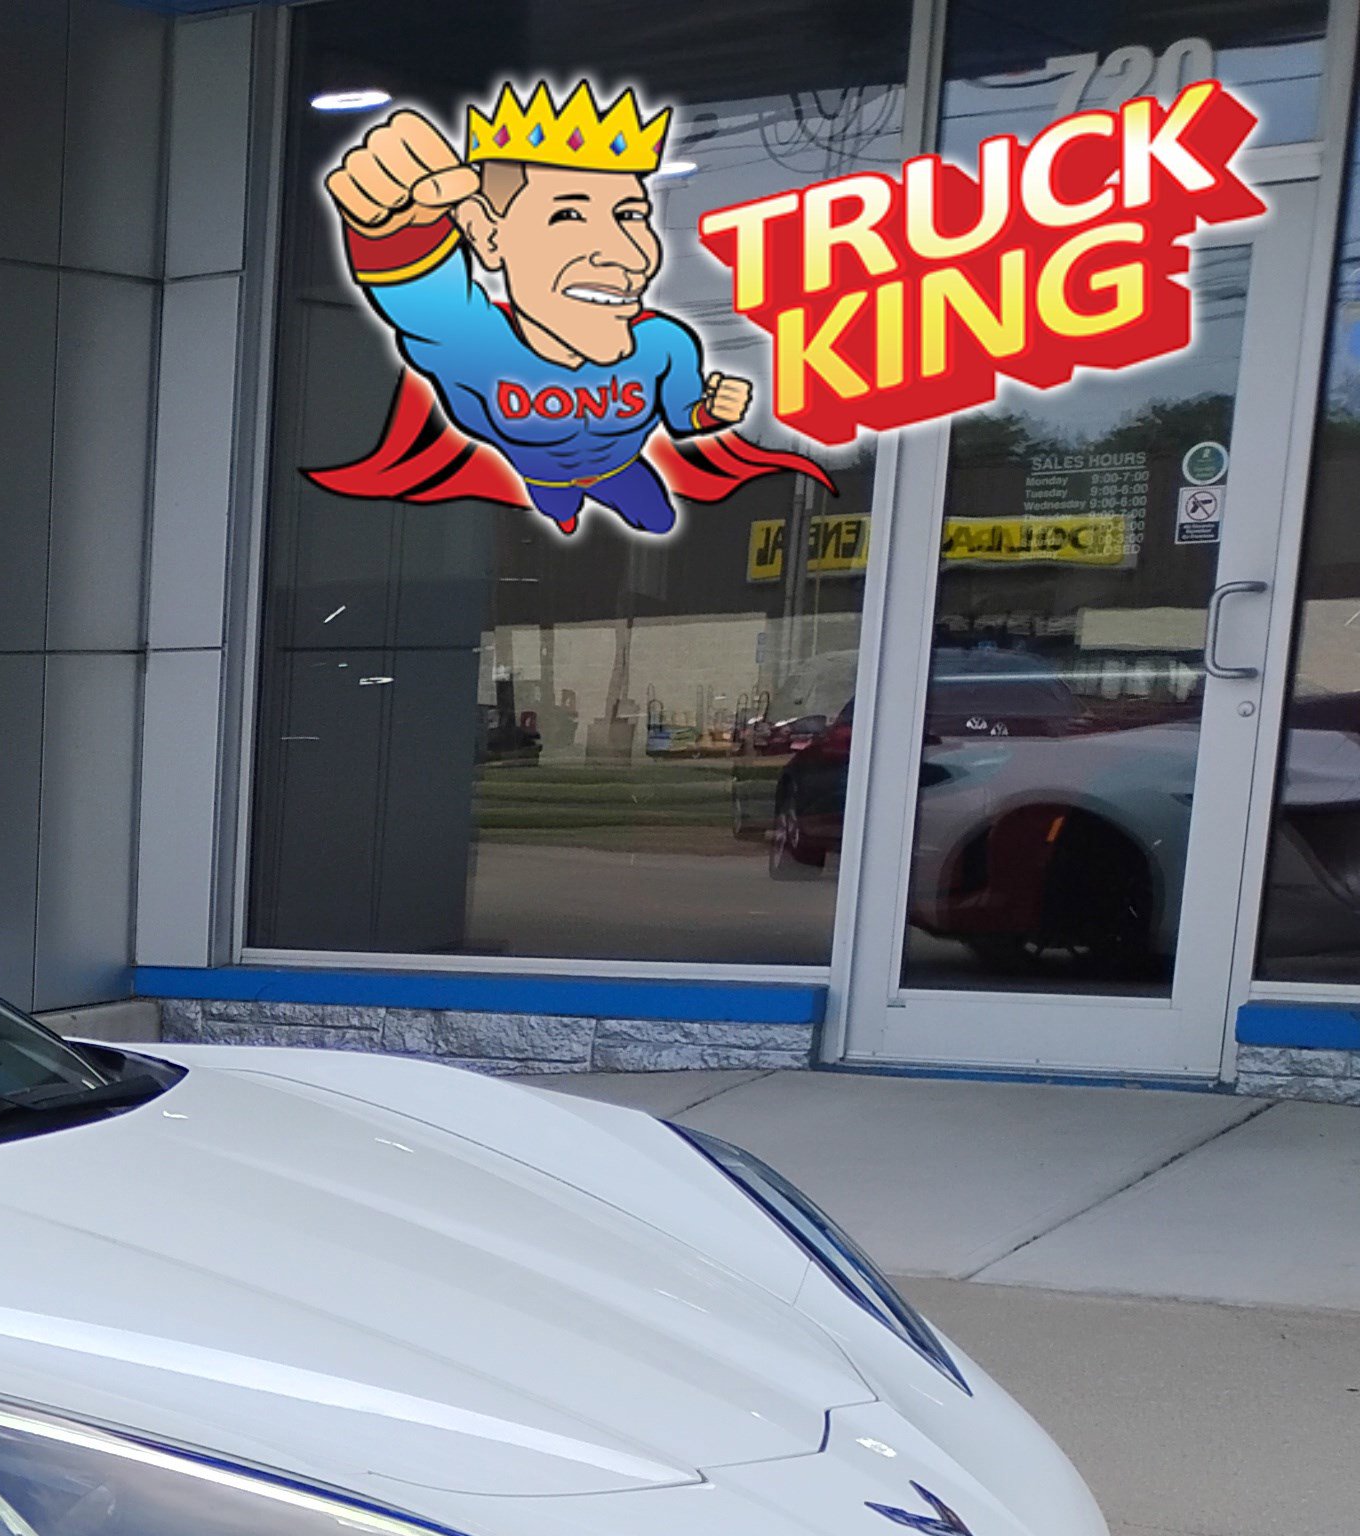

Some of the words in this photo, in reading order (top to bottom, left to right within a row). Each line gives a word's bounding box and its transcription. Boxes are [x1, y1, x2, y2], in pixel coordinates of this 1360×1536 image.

[1031, 455, 1084, 471] SALES
[1089, 451, 1147, 468] HOURS
[1025, 476, 1069, 487] Monday
[1091, 471, 1149, 484] 9:00-7:00
[1025, 488, 1068, 498] Tuesday
[1023, 500, 1087, 511] Wednesday
